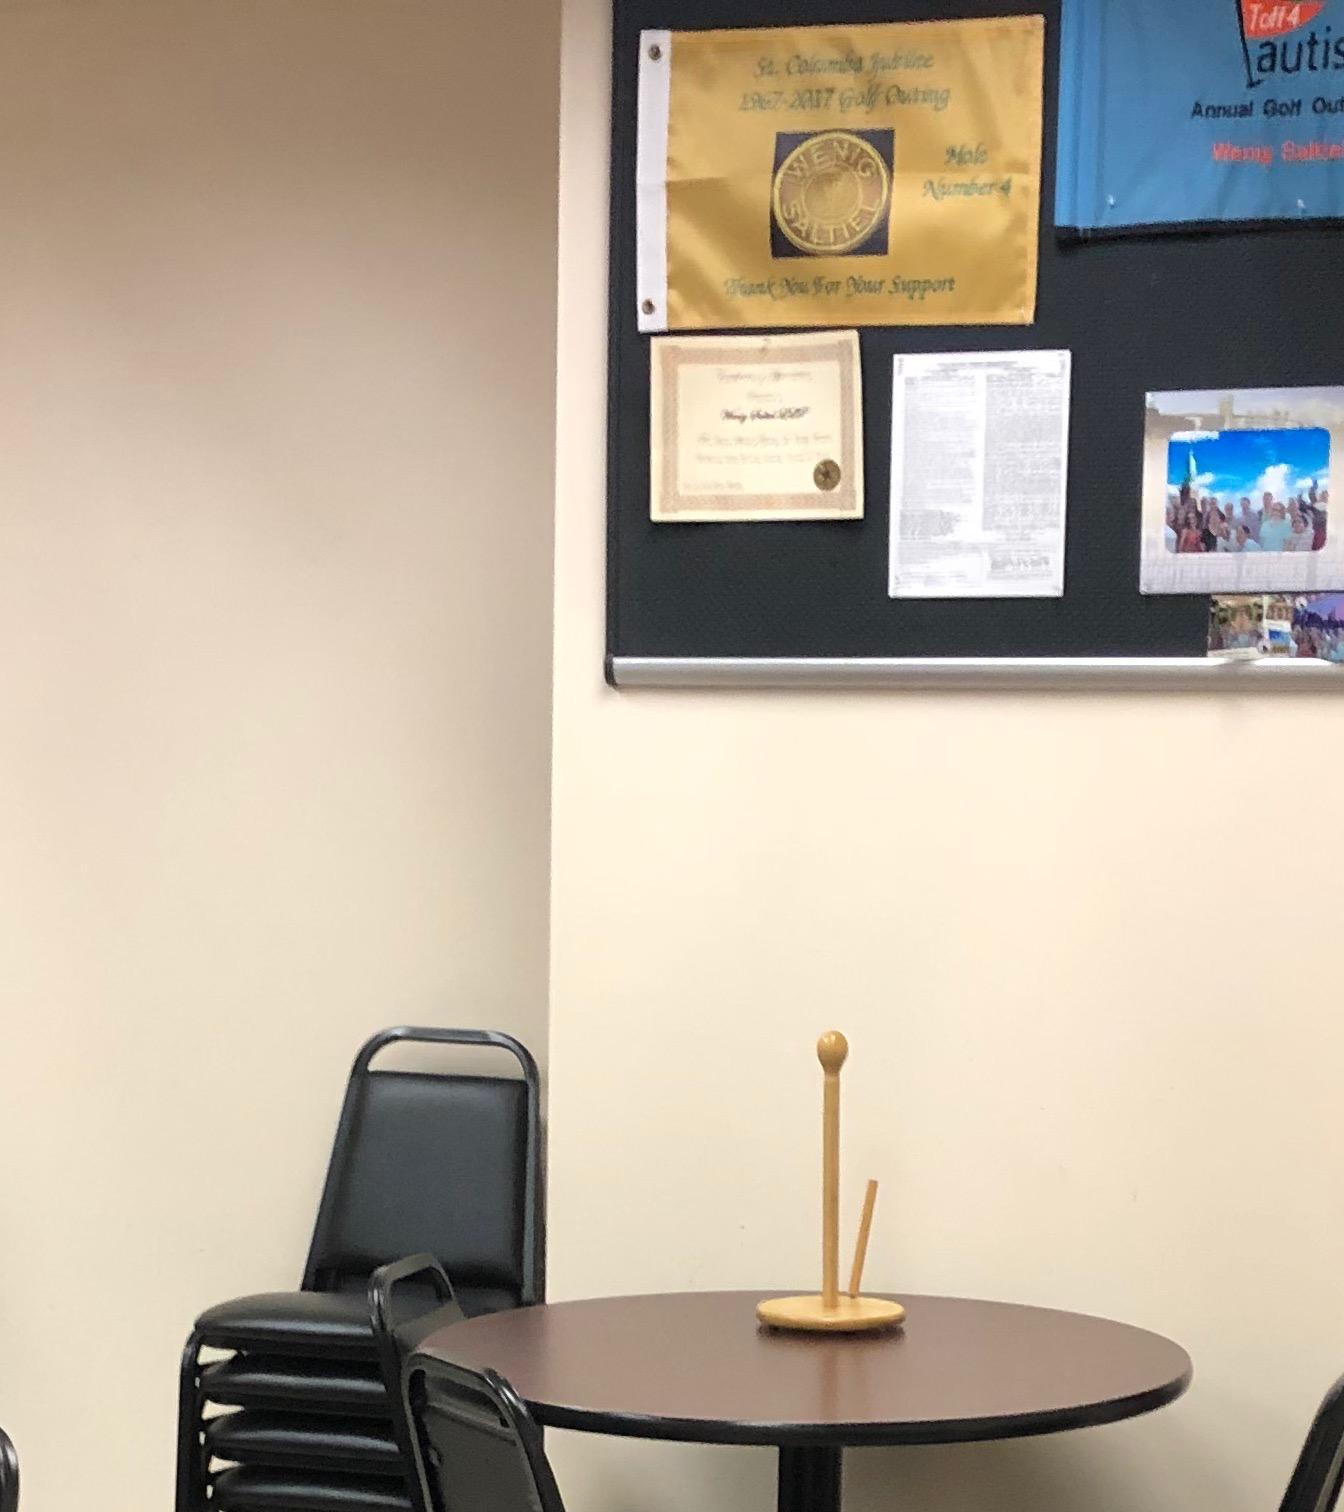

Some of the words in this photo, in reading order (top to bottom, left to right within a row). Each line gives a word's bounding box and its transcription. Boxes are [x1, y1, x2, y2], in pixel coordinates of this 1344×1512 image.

[839, 83, 881, 113] Golf
[885, 84, 951, 112] Outing
[1190, 100, 1254, 118] Annual
[1262, 98, 1303, 117] Golf
[785, 140, 877, 178] WENIG
[923, 177, 994, 200] Number
[782, 200, 878, 243] SALTIEL
[724, 277, 775, 300] Thank
[780, 277, 808, 297] You
[812, 275, 842, 296] For
[846, 275, 885, 297] Your
[888, 274, 955, 300] Support
